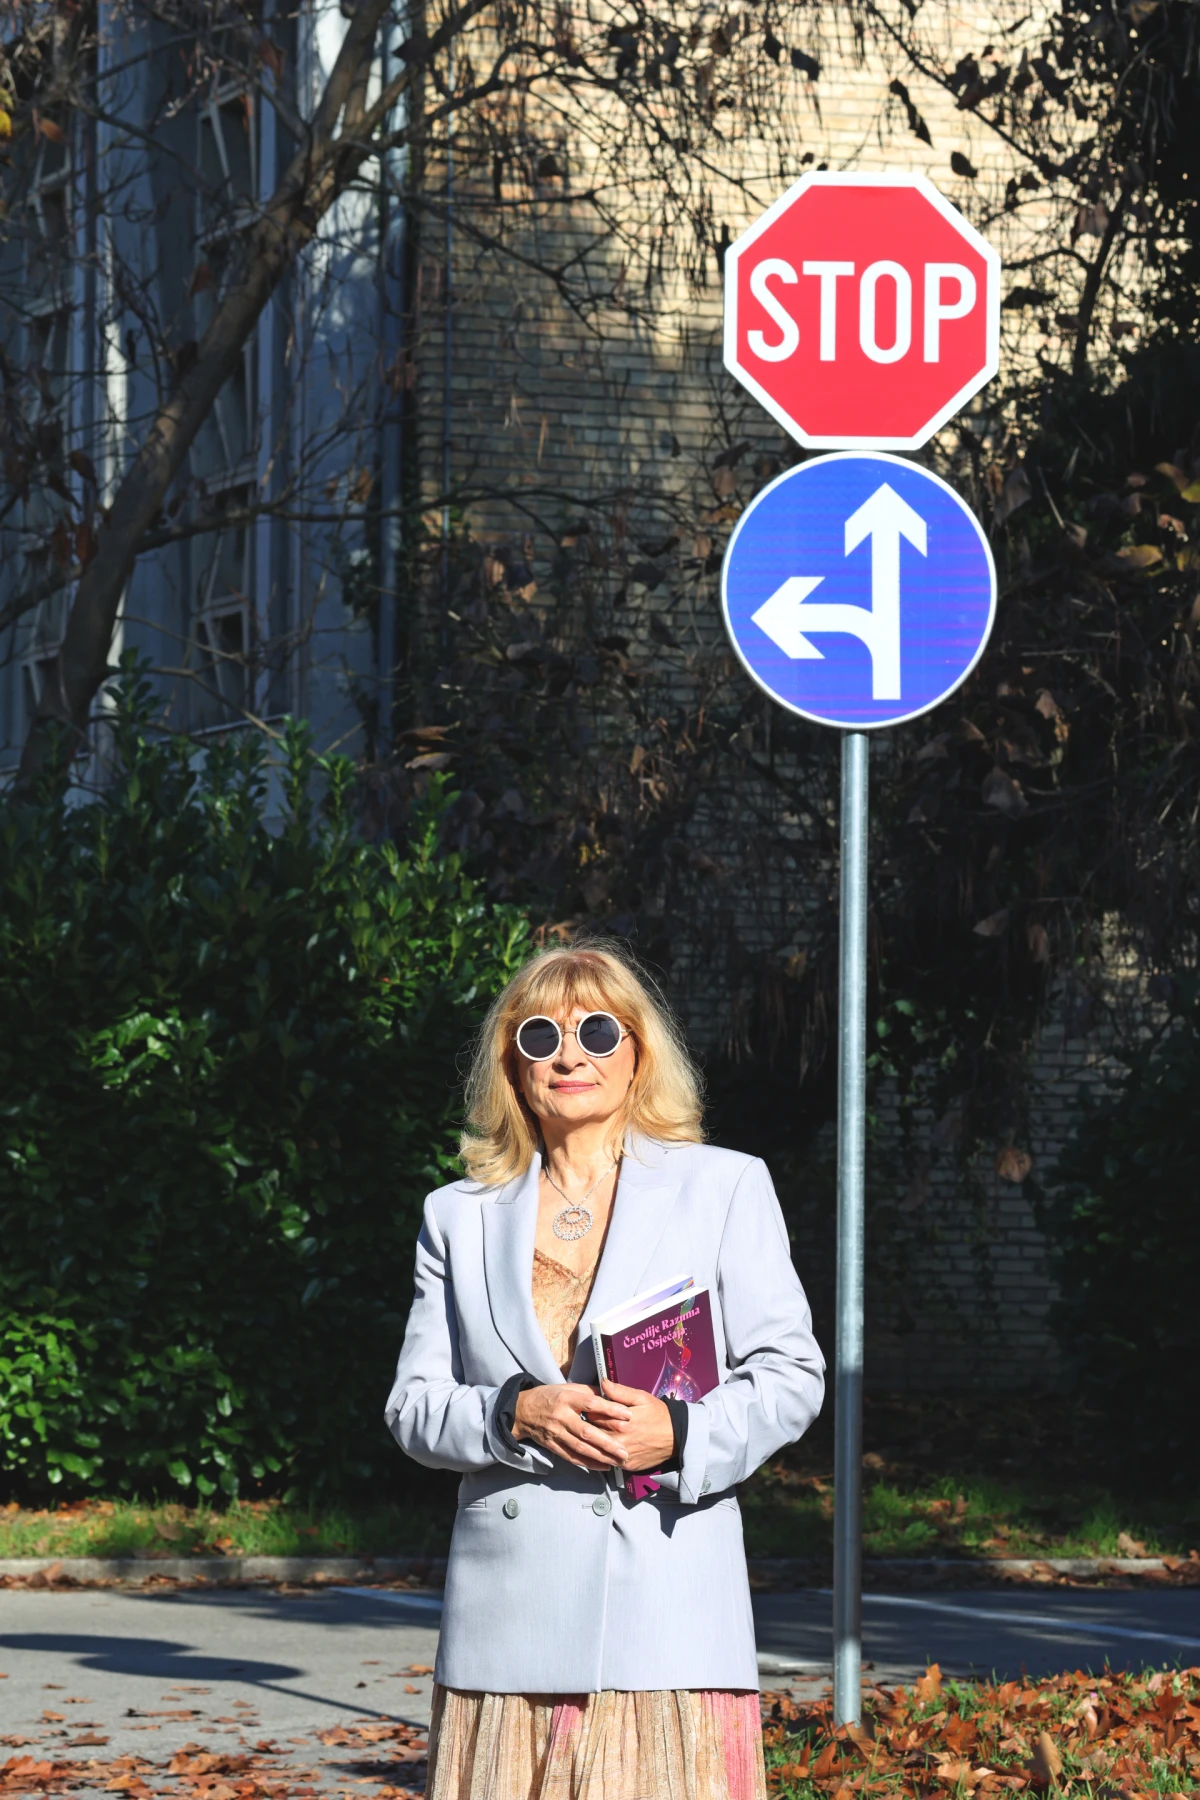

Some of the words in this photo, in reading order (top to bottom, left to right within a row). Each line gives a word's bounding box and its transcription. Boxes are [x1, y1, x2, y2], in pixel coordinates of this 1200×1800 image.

[747, 258, 977, 364] STOP
[623, 1324, 660, 1348] Čarolije
[661, 1307, 701, 1331] Razuma
[641, 1342, 647, 1354] i
[647, 1326, 686, 1350] Osjećaja
